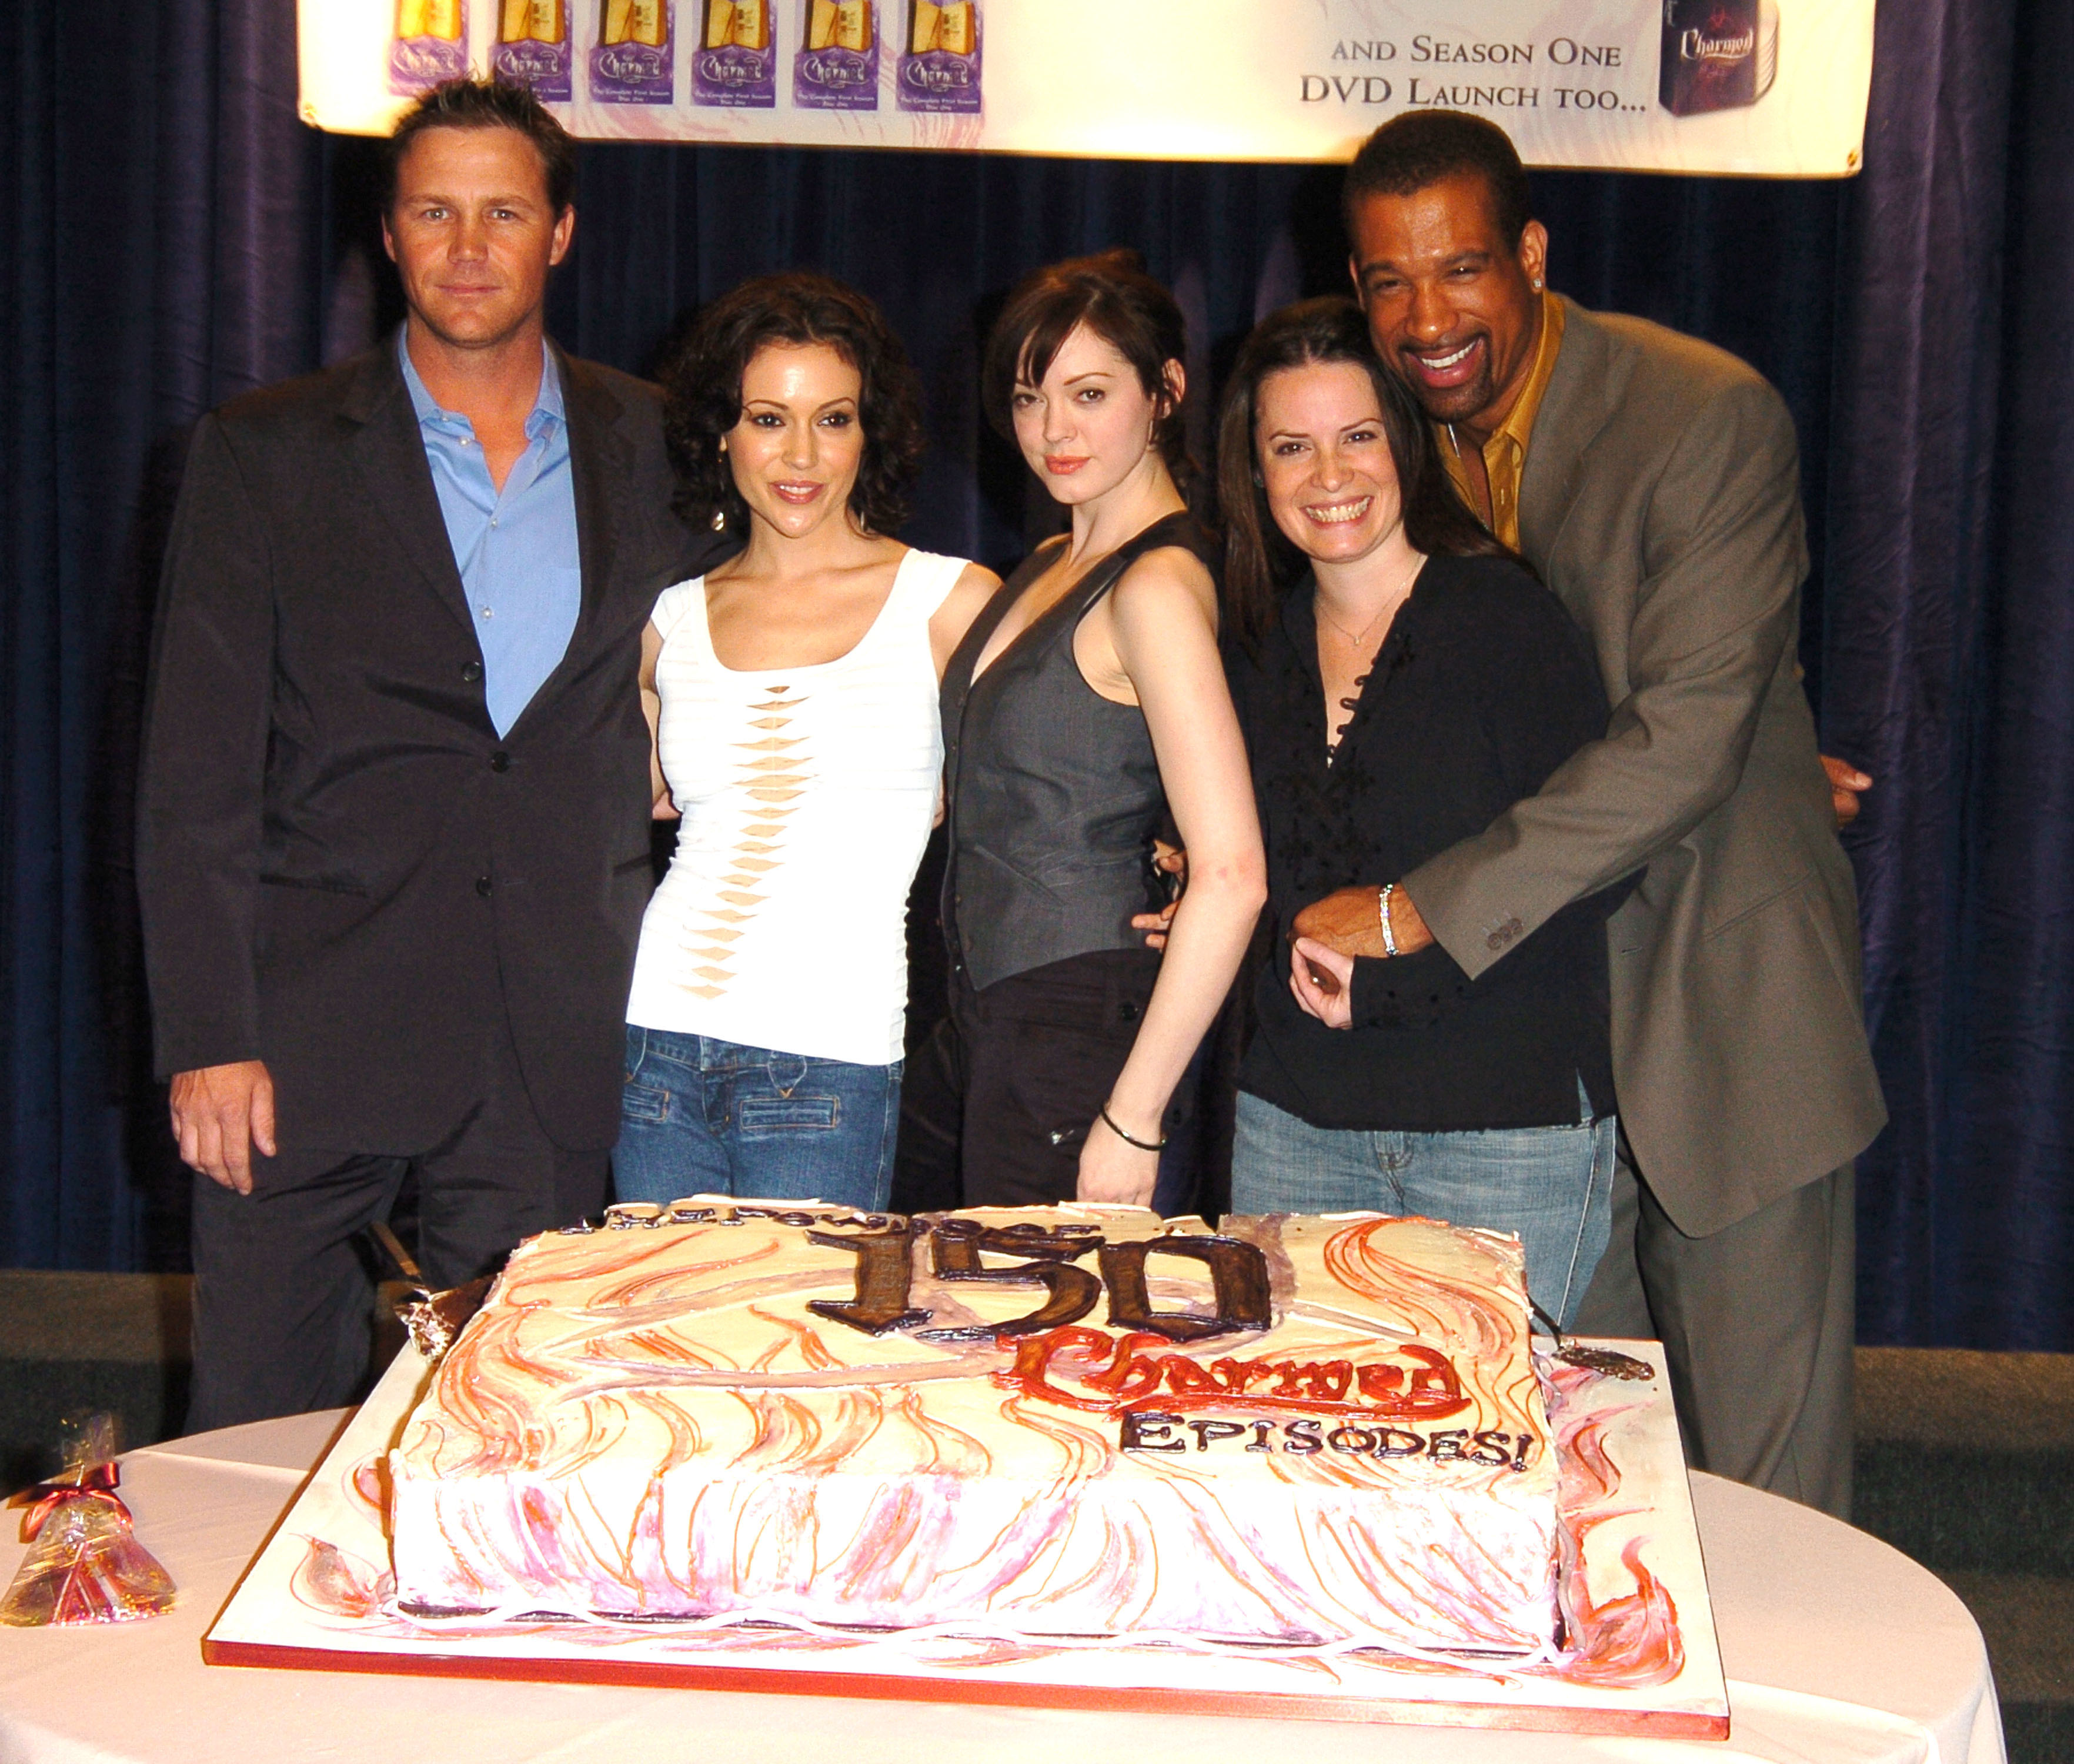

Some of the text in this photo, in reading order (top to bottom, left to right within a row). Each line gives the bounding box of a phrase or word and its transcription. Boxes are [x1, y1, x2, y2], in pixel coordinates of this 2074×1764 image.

[1331, 35, 1621, 66] AND SEASON ONE
[1680, 27, 1754, 60] Charmed
[1300, 74, 1392, 103] DVD
[1408, 78, 1539, 107] LAUNCH
[805, 1228, 1273, 1344] 150
[991, 1324, 1473, 1422] Charmed
[1120, 1411, 1530, 1472] EPISODES!
